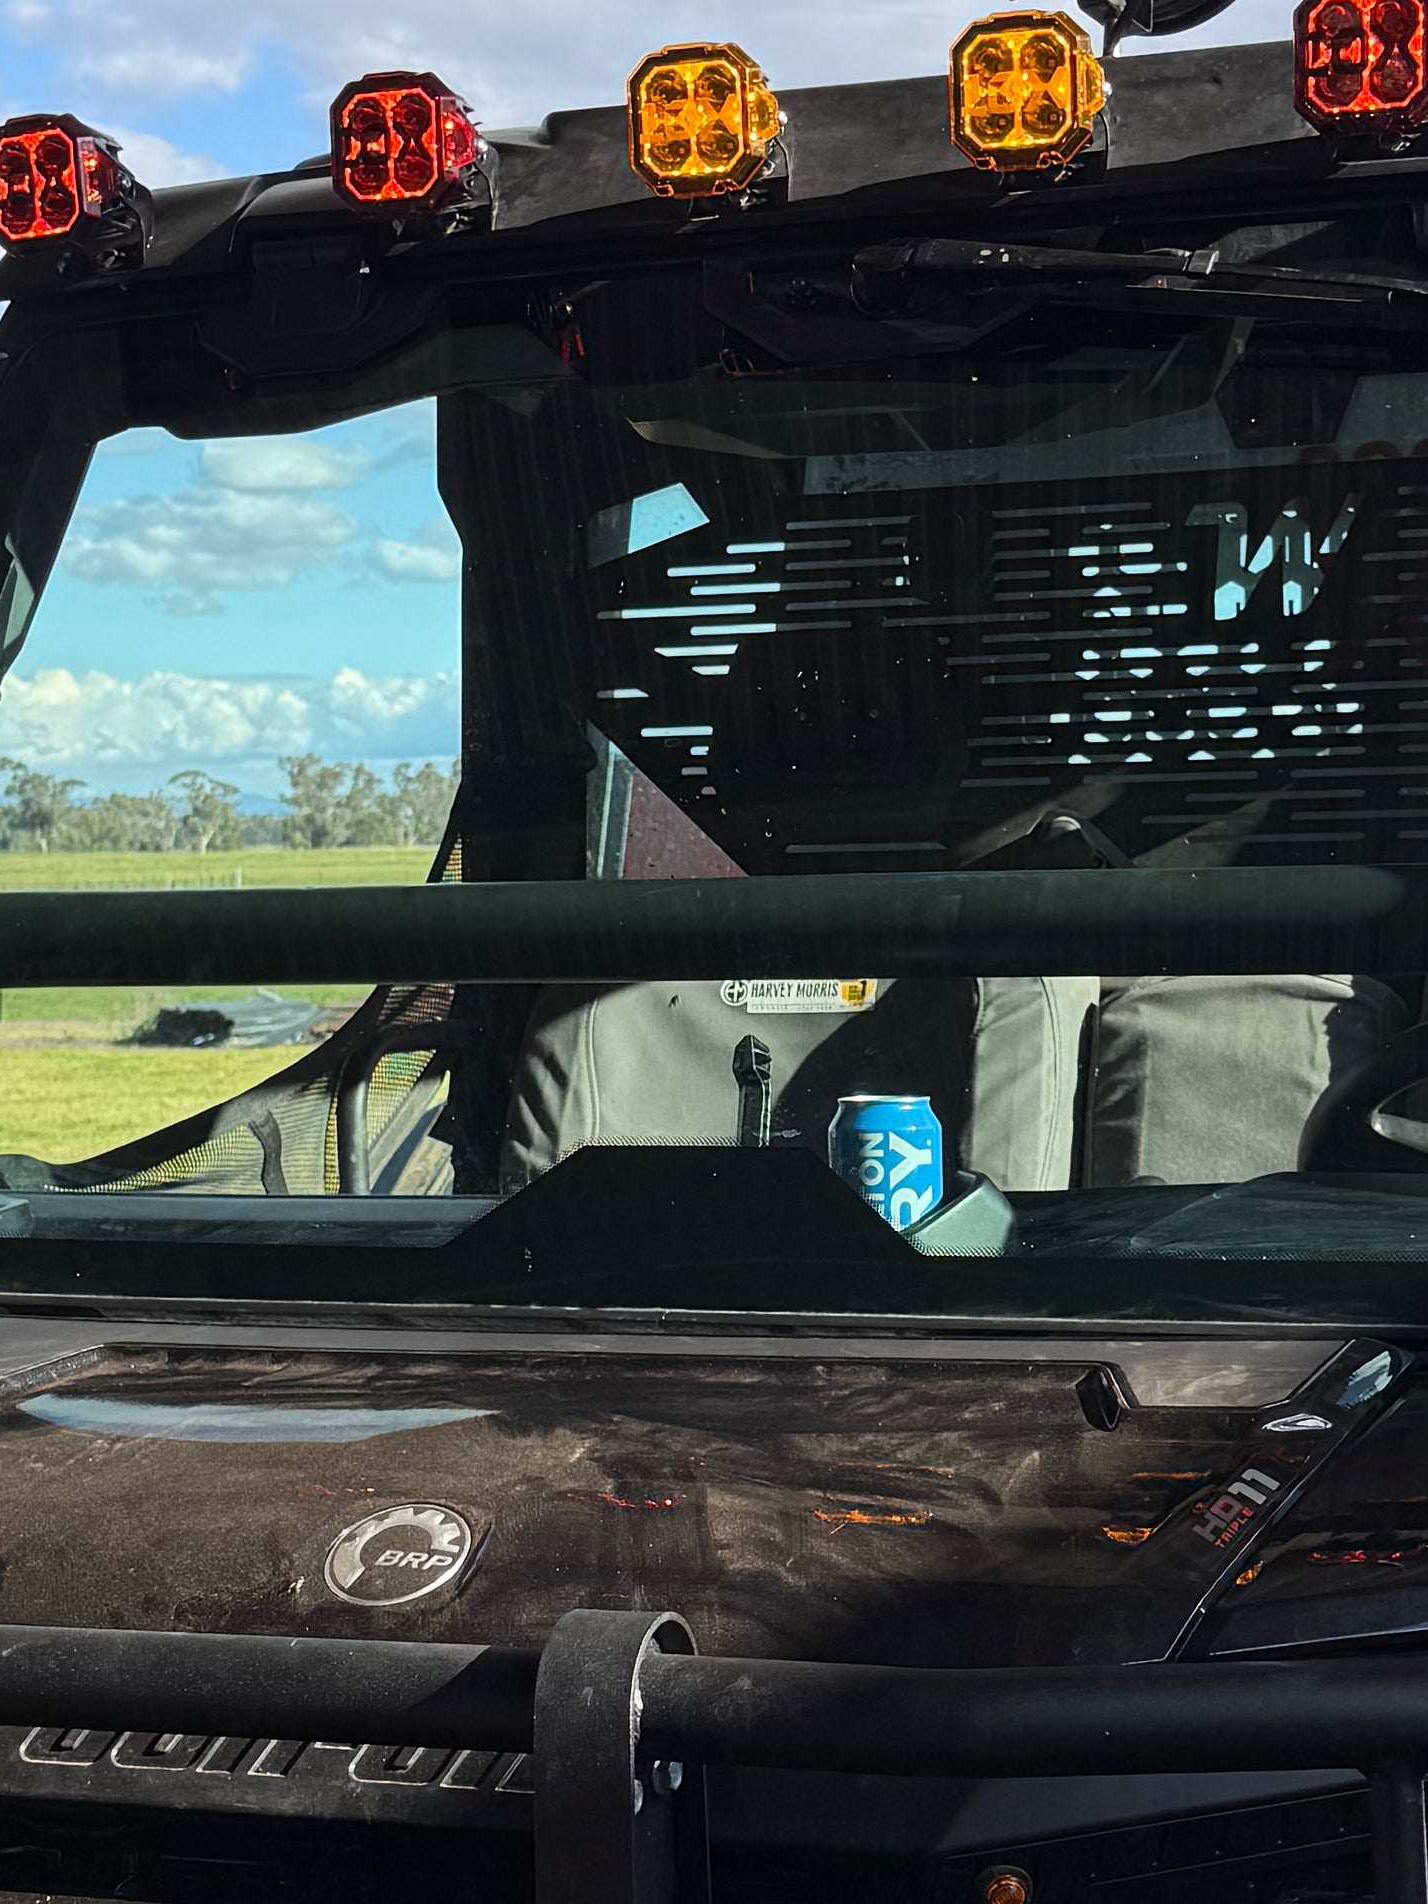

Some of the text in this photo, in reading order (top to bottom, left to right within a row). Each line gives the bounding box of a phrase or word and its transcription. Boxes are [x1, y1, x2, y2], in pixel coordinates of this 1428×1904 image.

[751, 982, 793, 998] HARVEY
[796, 982, 839, 998] MORRIS
[889, 1131, 933, 1232] RY
[1192, 1468, 1281, 1544] HD11
[375, 1550, 453, 1570] BRP
